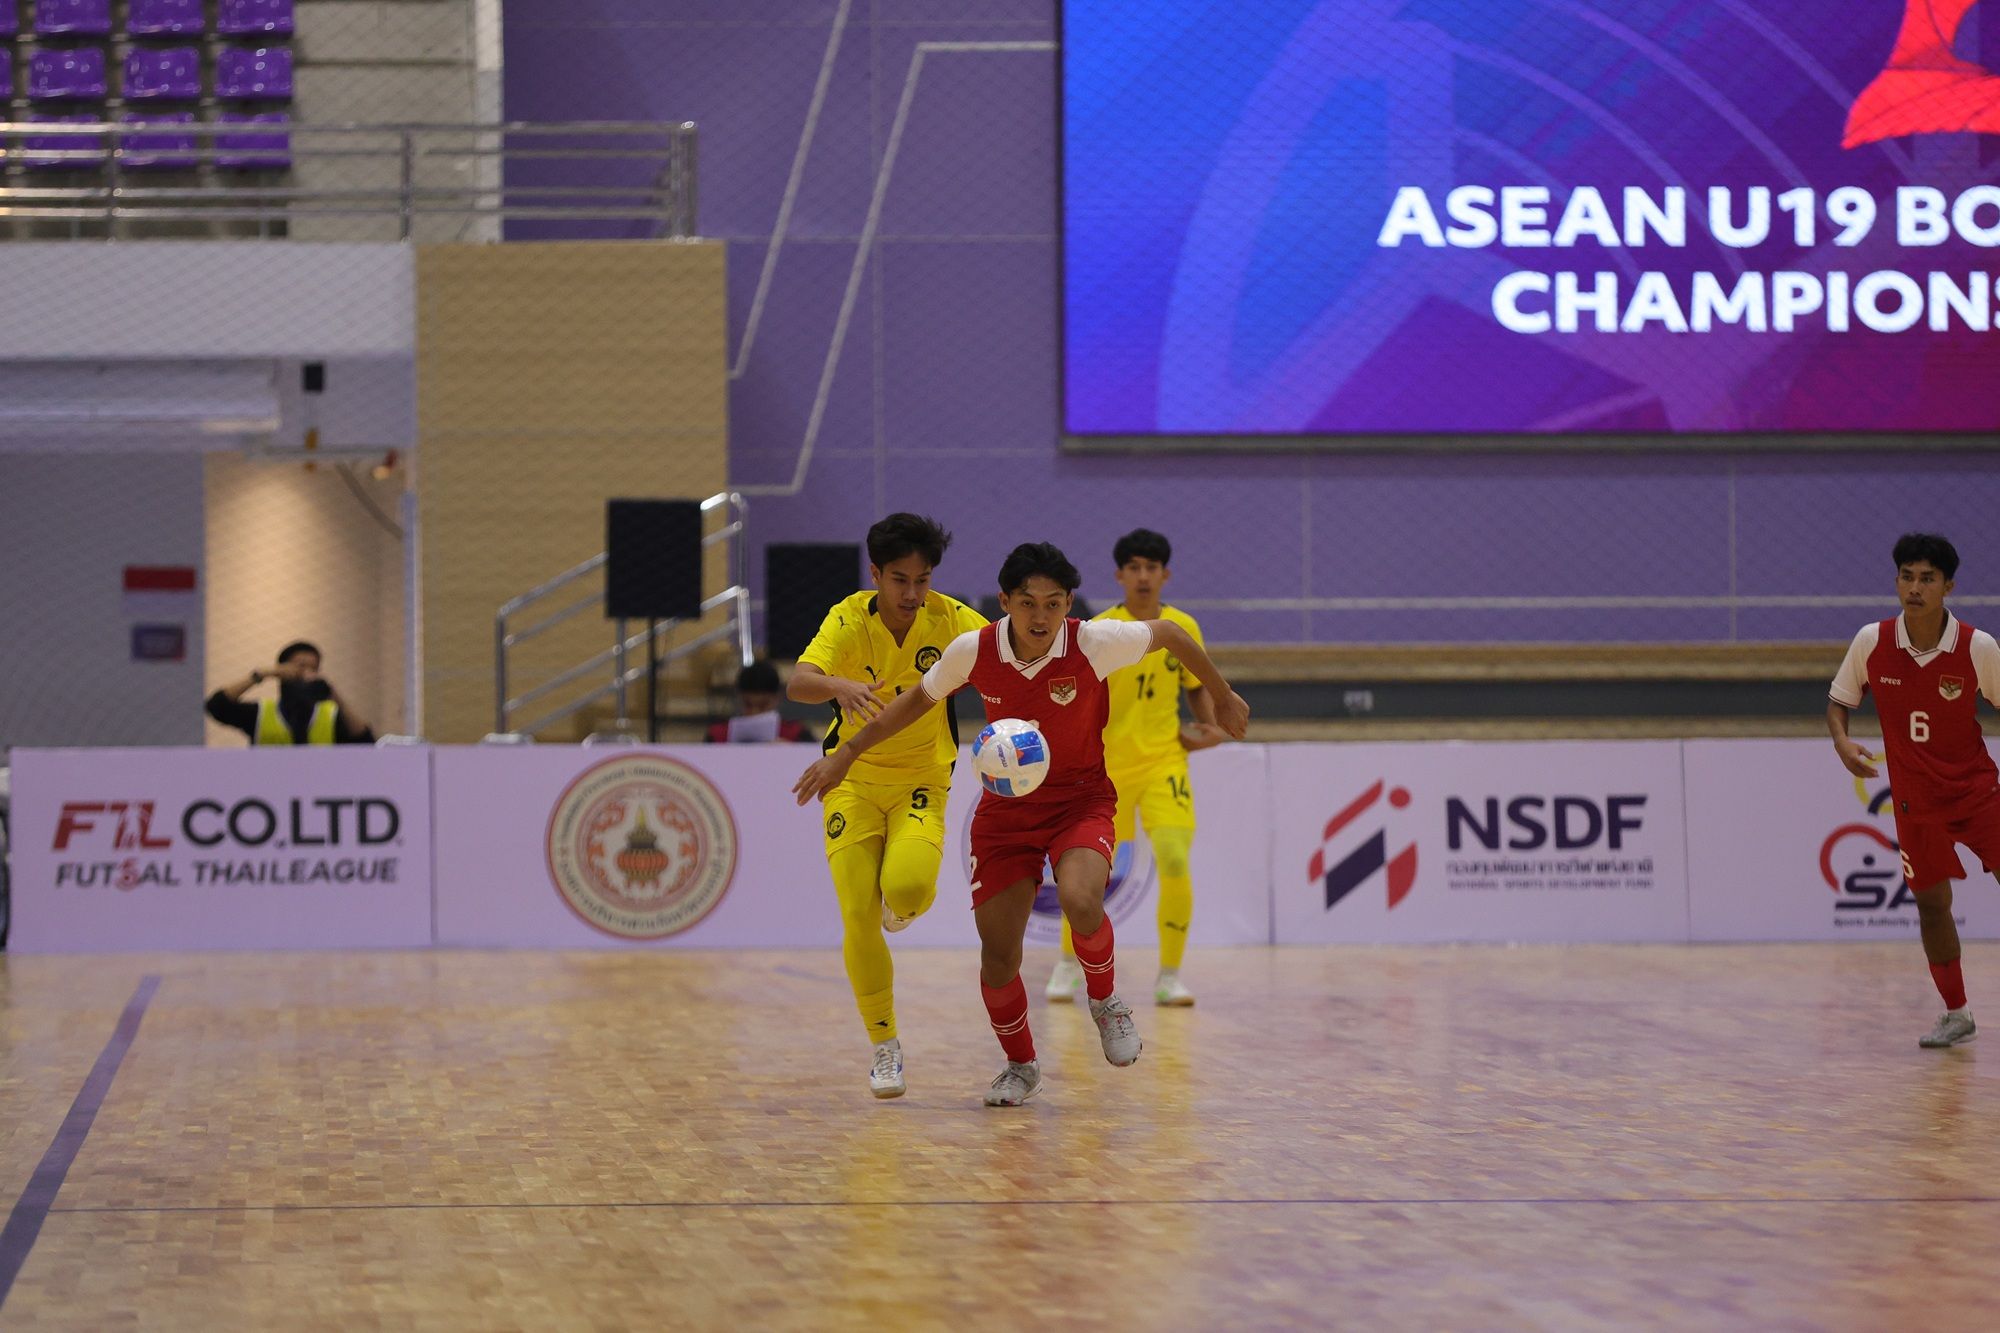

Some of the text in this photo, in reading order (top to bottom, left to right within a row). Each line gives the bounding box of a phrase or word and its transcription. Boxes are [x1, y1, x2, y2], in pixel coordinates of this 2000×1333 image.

[1377, 185, 2000, 248] ASEAN U19 BO
[1491, 270, 2000, 333] CHAMPION
[1910, 711, 1930, 743] 6
[911, 787, 930, 810] 5
[1167, 775, 1190, 800] 14
[1446, 796, 1648, 851] NSDF
[193, 857, 398, 885] THAILEAGUE
